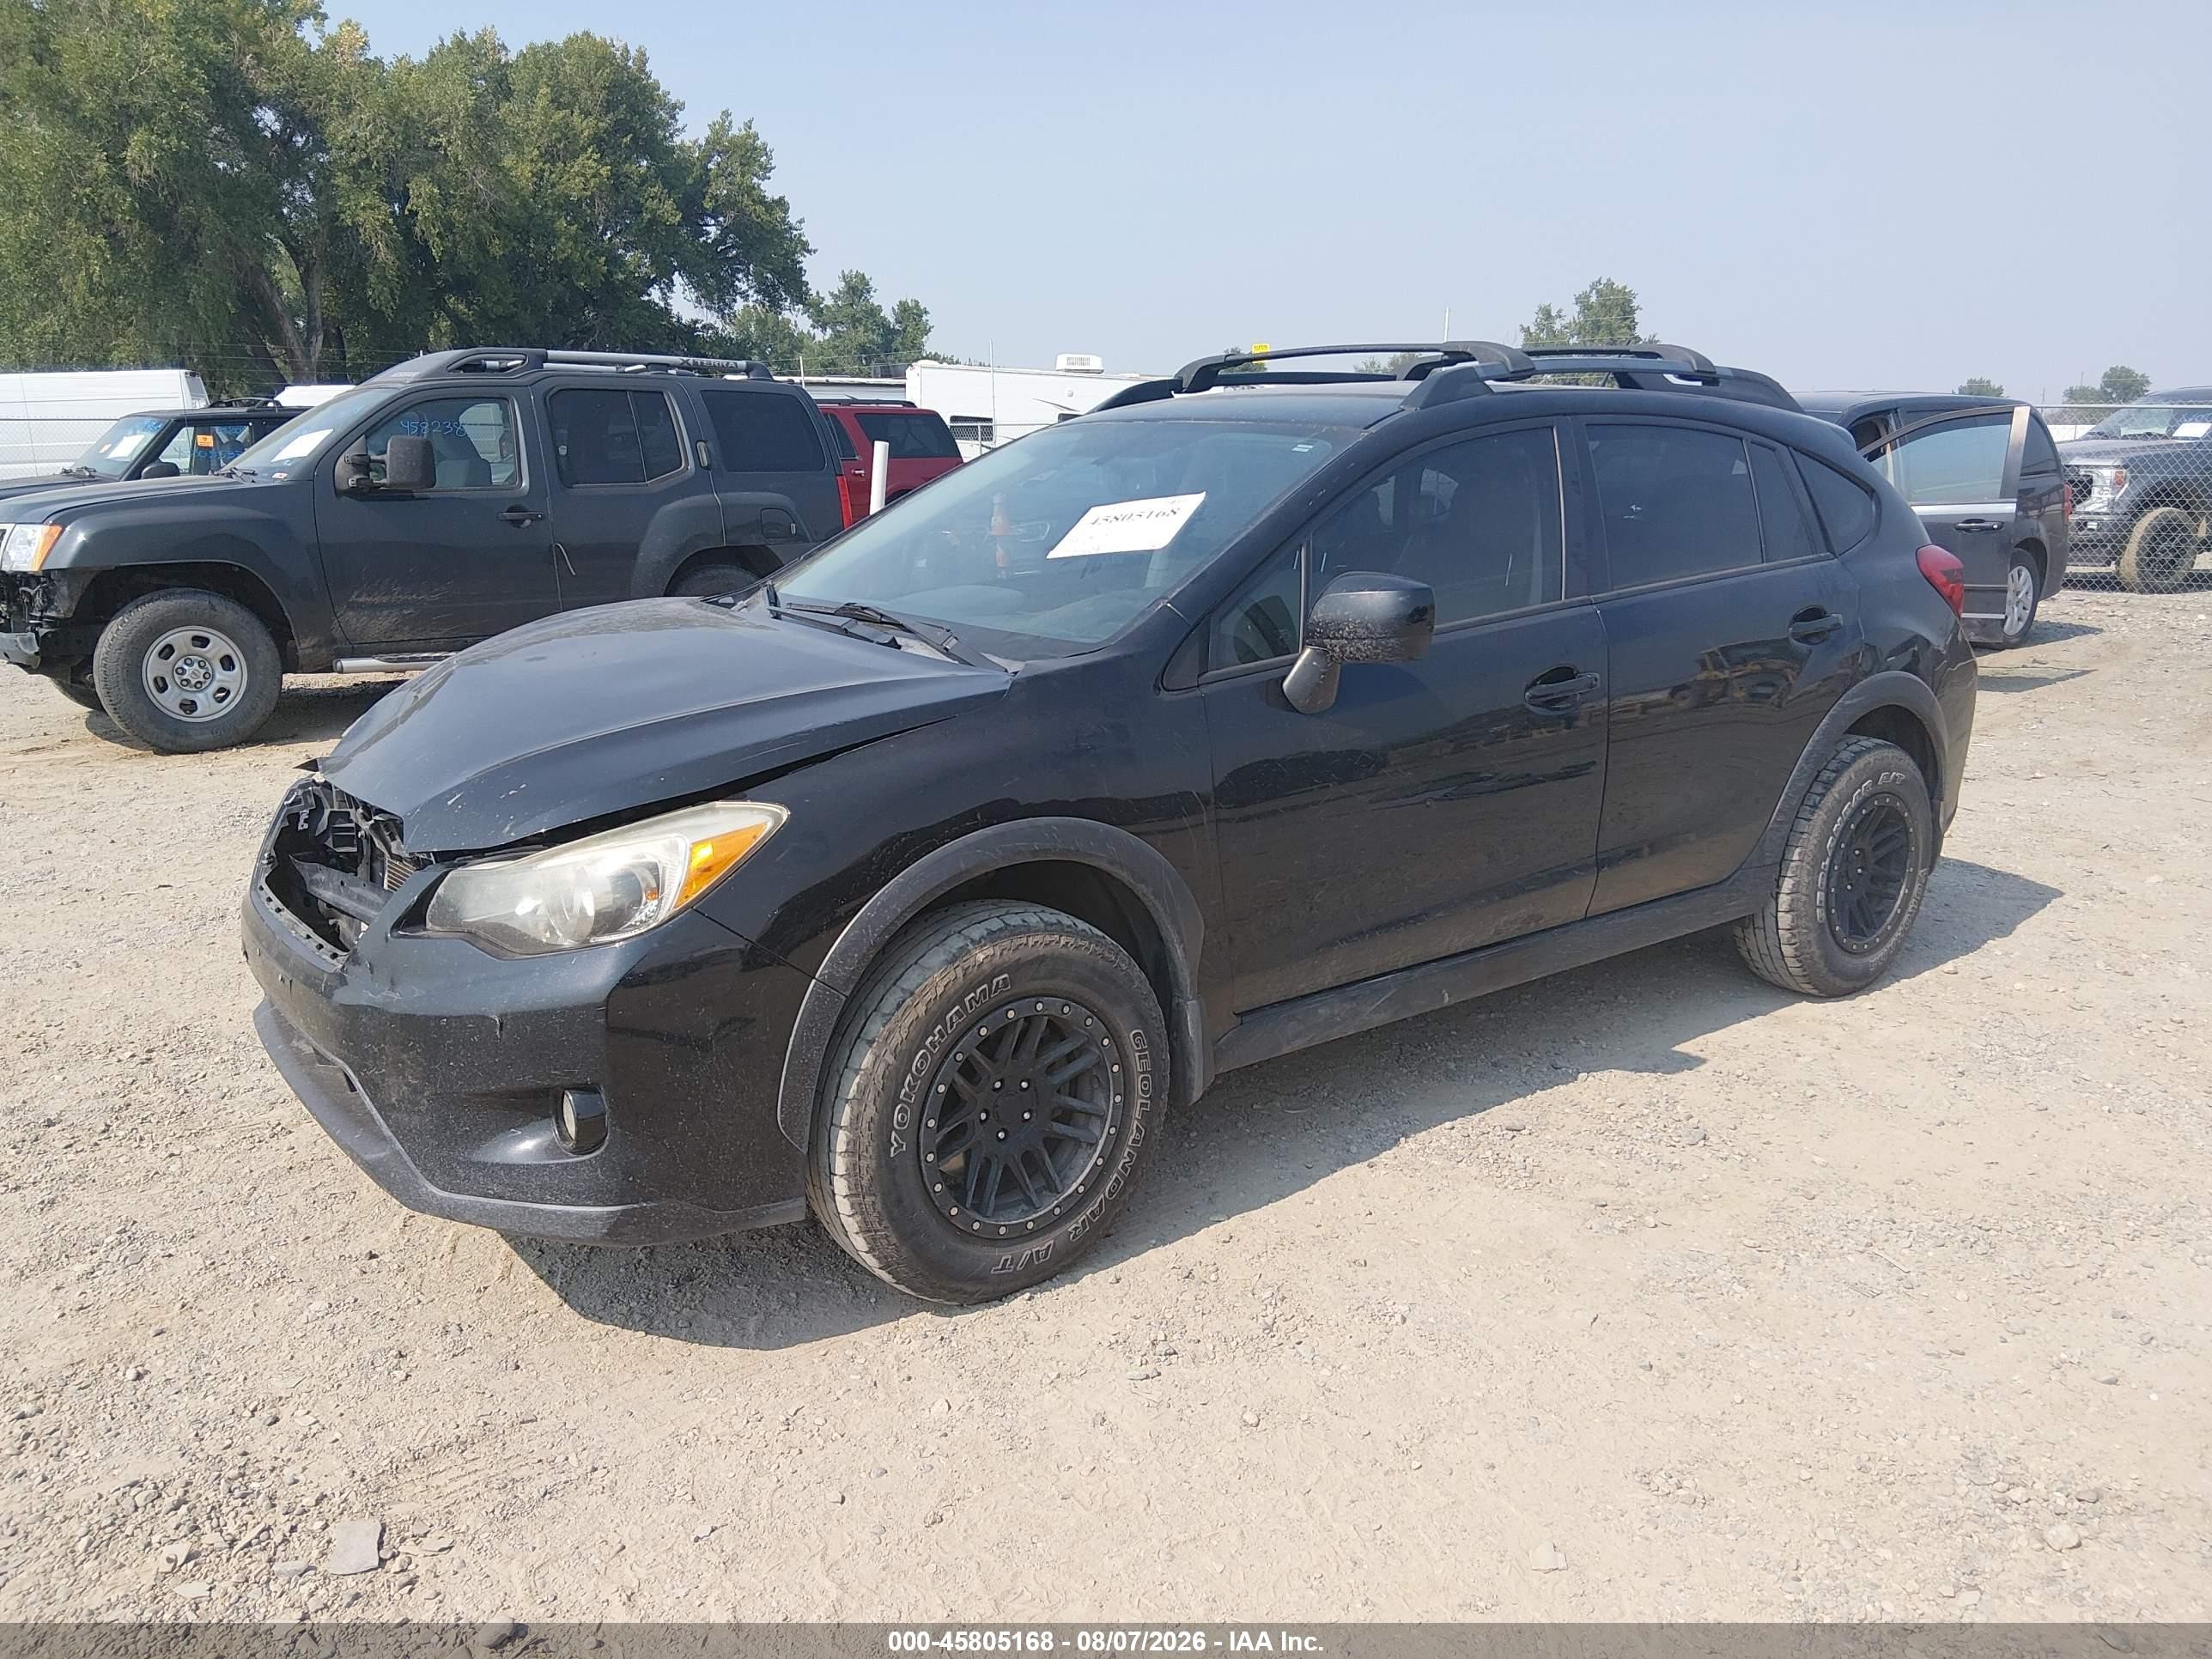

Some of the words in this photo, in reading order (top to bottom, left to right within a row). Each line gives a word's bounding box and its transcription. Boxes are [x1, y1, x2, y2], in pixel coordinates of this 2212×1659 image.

[679, 357, 737, 368] XTERRA
[890, 973, 1012, 1158] YOKOHAMA
[1067, 1030, 1152, 1242] GEOLANDAR
[990, 1240, 1054, 1274] A/T
